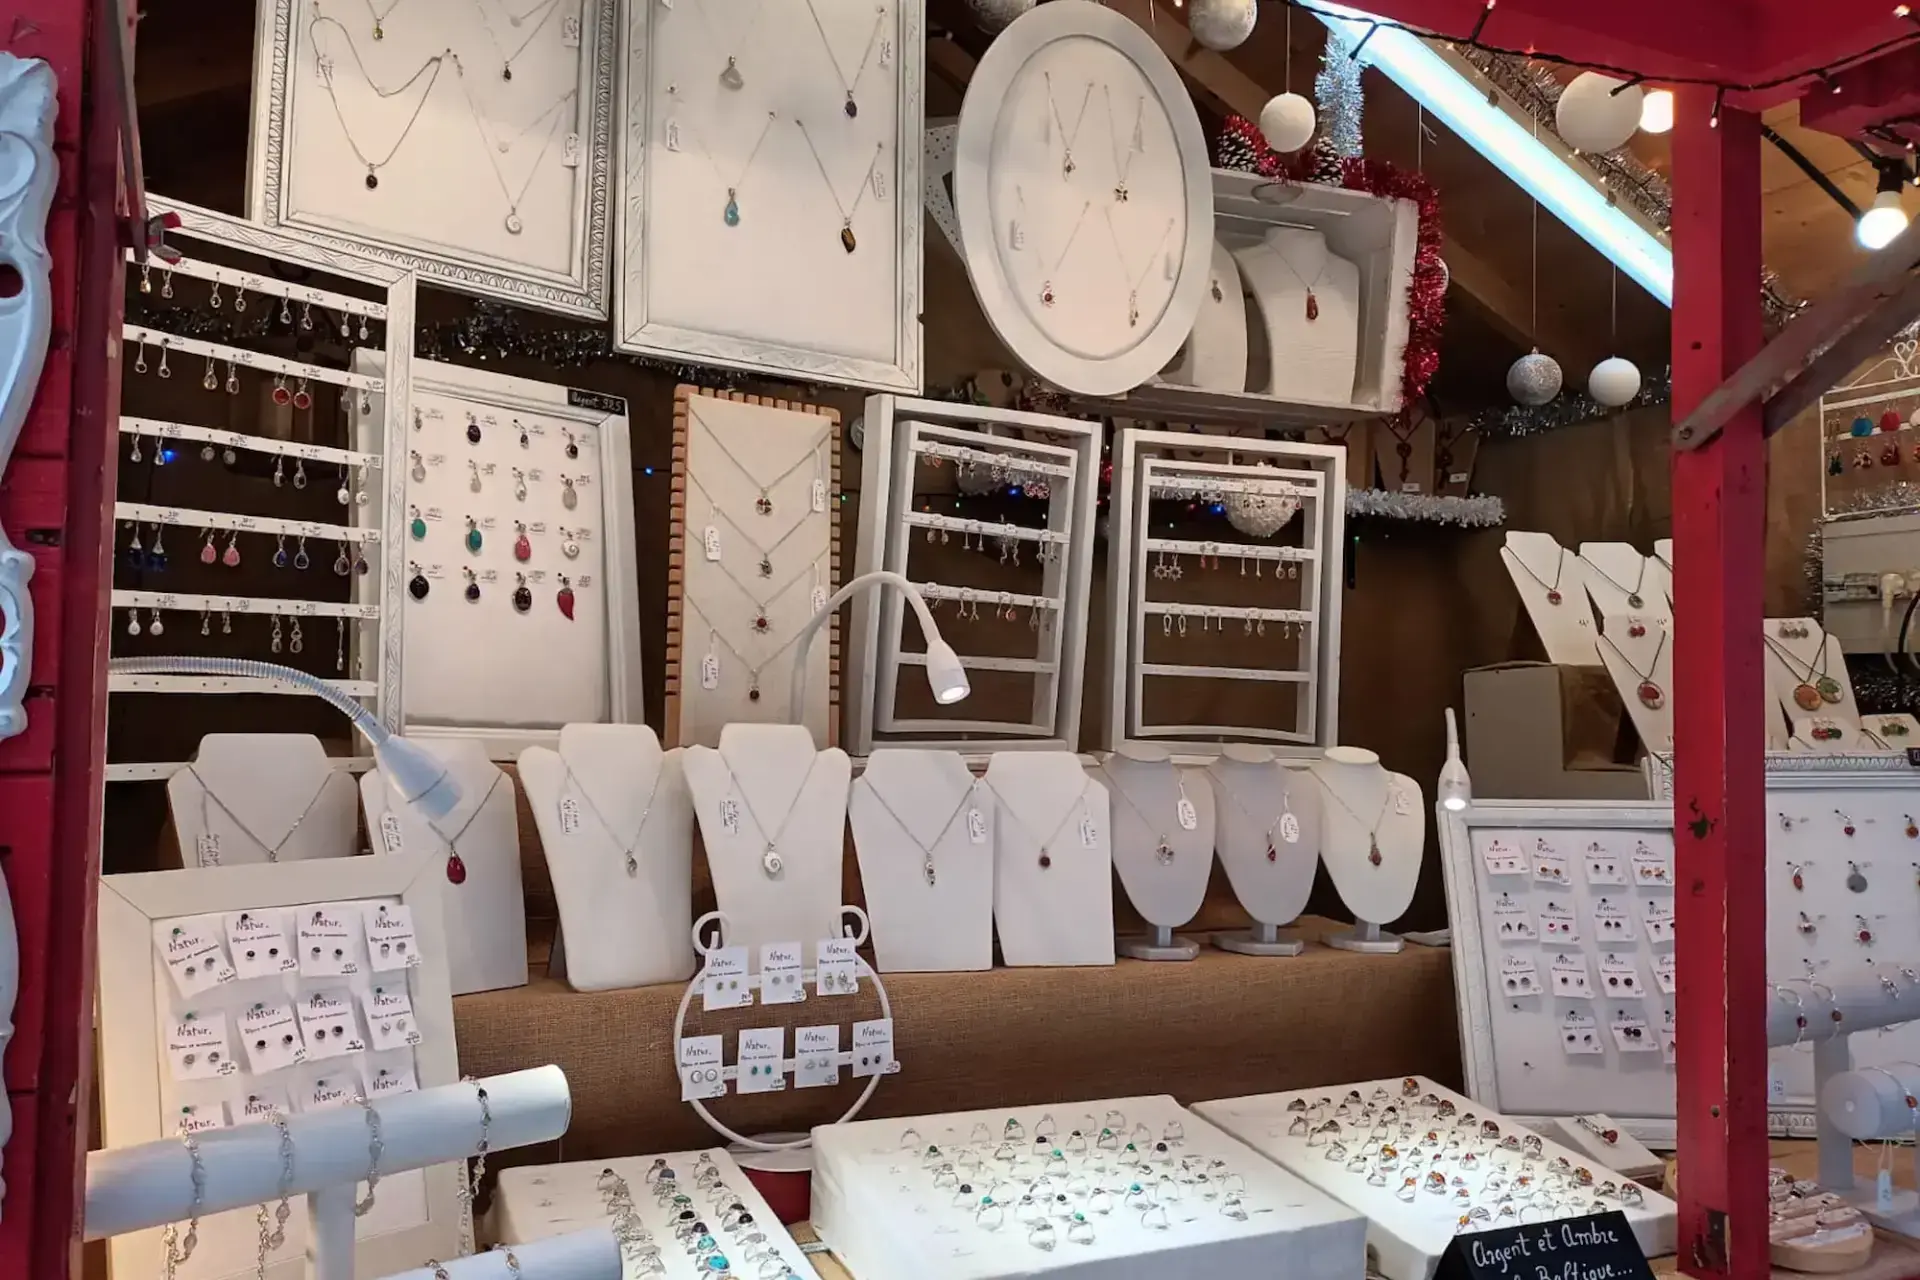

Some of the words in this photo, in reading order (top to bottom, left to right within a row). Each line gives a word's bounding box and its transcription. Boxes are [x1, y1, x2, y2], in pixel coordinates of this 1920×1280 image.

[1472, 1232, 1531, 1273] Argent
[1538, 1227, 1557, 1252] et
[1561, 1221, 1619, 1248] Ambre
